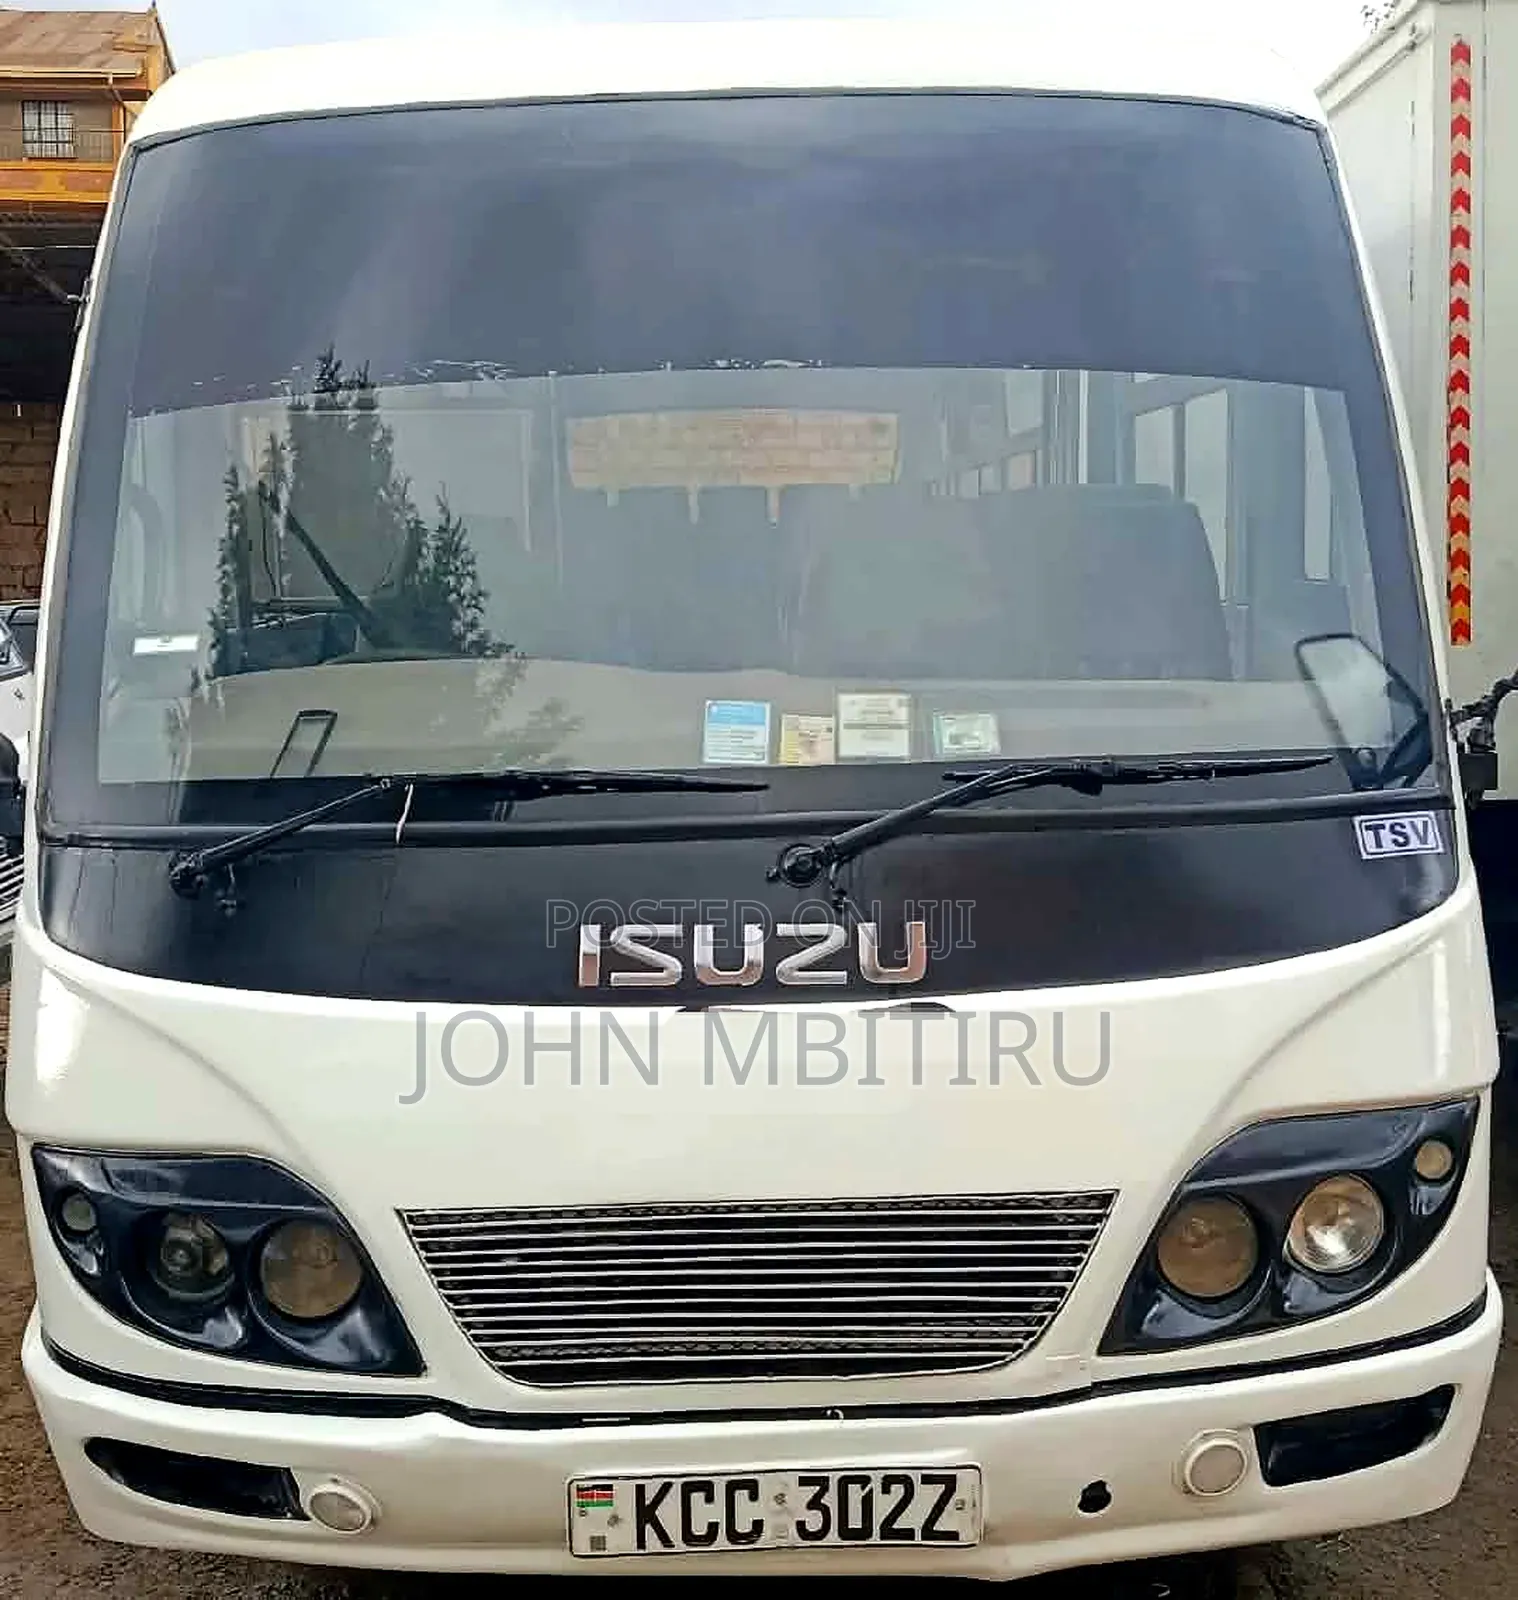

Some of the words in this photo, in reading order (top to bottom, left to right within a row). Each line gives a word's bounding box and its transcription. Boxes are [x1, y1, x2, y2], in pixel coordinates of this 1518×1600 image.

[1364, 820, 1430, 849] TSV
[578, 921, 928, 987] ISUZU
[634, 1478, 765, 1550] KCC
[795, 1473, 961, 1542] 302Z
